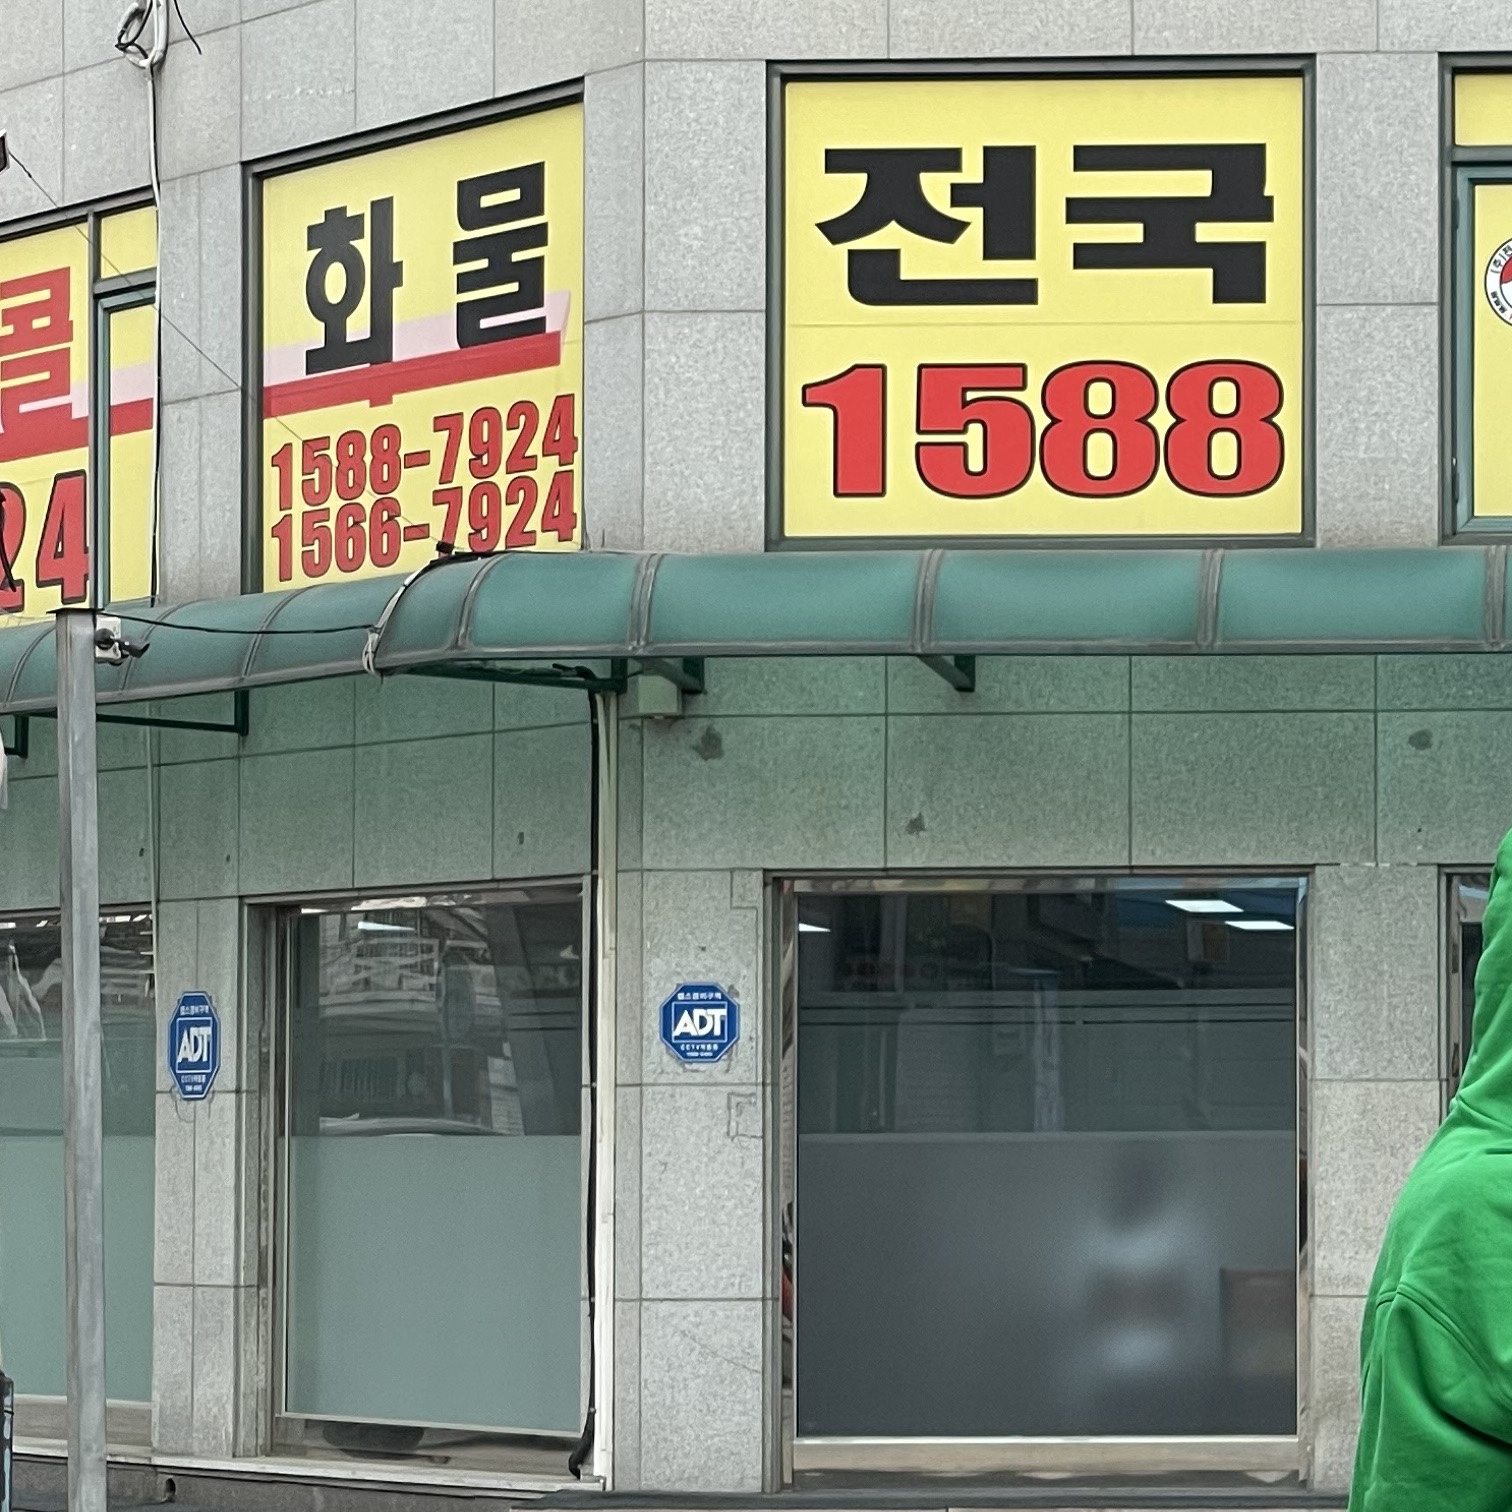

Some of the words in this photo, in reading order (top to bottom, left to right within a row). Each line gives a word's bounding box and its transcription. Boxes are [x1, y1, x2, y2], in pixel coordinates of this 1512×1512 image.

[305, 161, 549, 375] 화물
[815, 143, 1274, 306] 전국
[271, 394, 578, 511] 1588-7924
[802, 359, 1285, 498] 1588
[271, 470, 577, 582] 1566-7924
[176, 1026, 212, 1063] ADT
[672, 1008, 727, 1037] ADT
